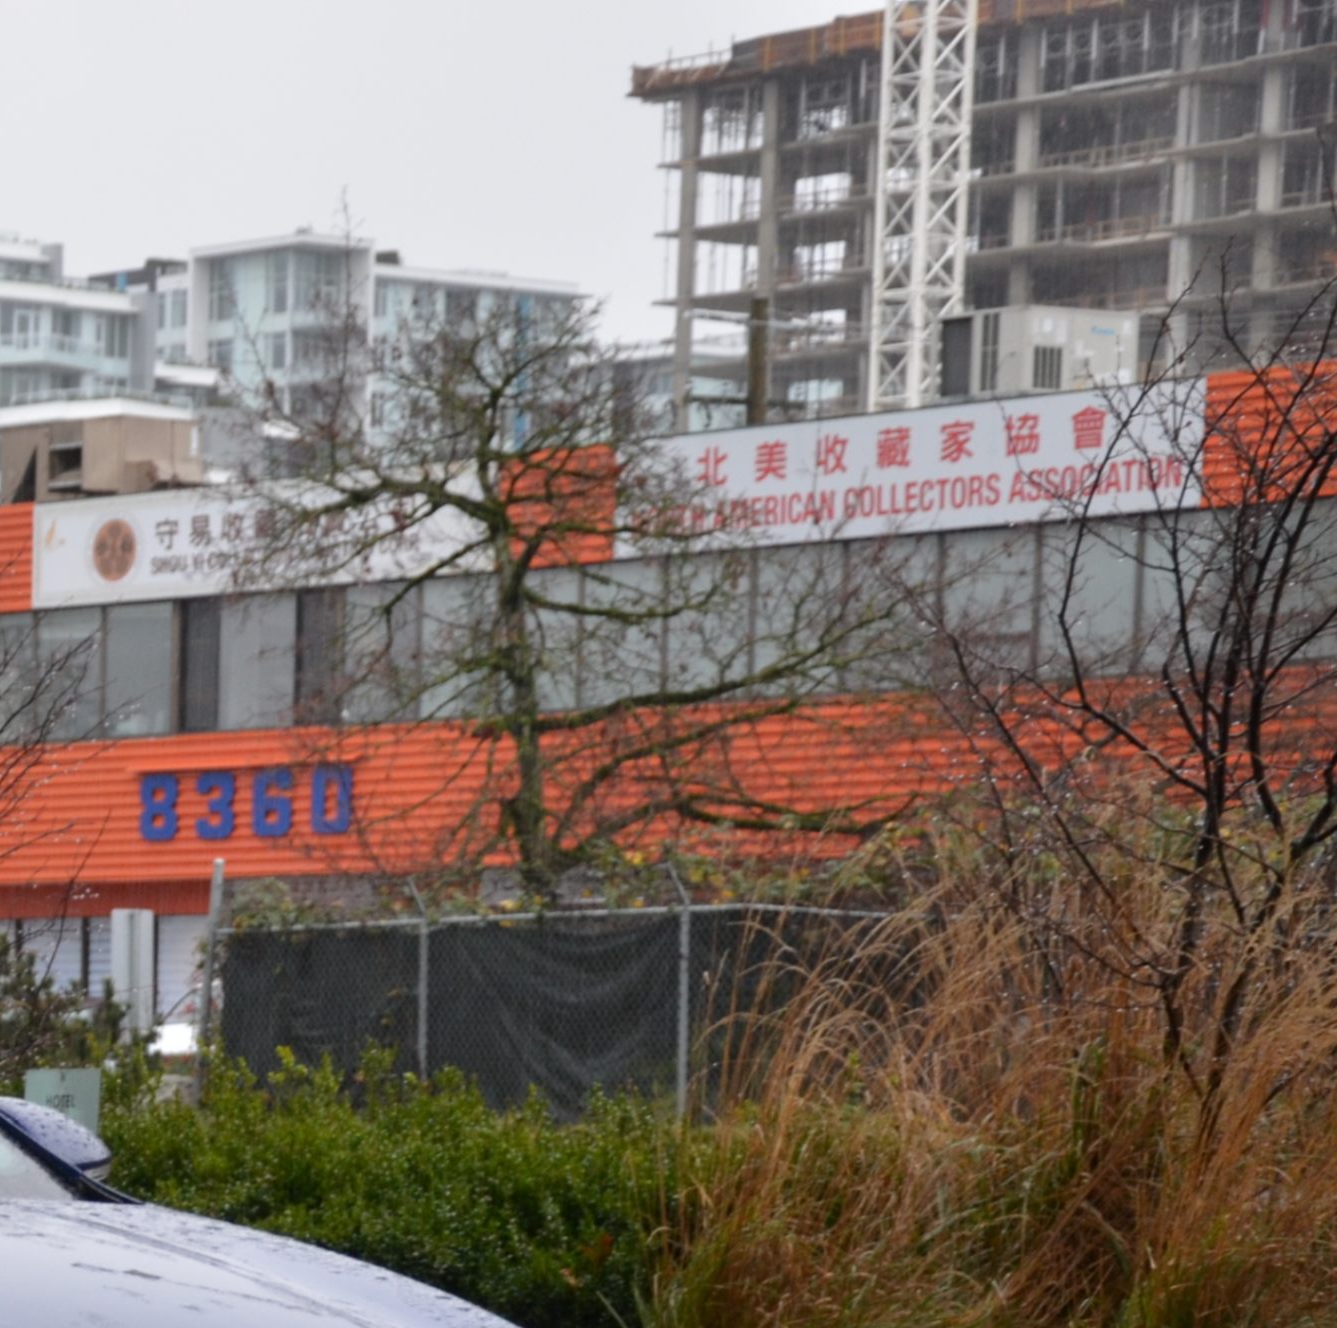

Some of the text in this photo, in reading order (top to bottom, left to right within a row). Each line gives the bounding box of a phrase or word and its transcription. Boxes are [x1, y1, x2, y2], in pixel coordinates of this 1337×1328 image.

[696, 405, 1107, 487] 北美收藏家協會
[843, 472, 1002, 520] COLLECTORS
[1008, 455, 1183, 503] ASSOCIATION
[139, 764, 354, 843] 8360
